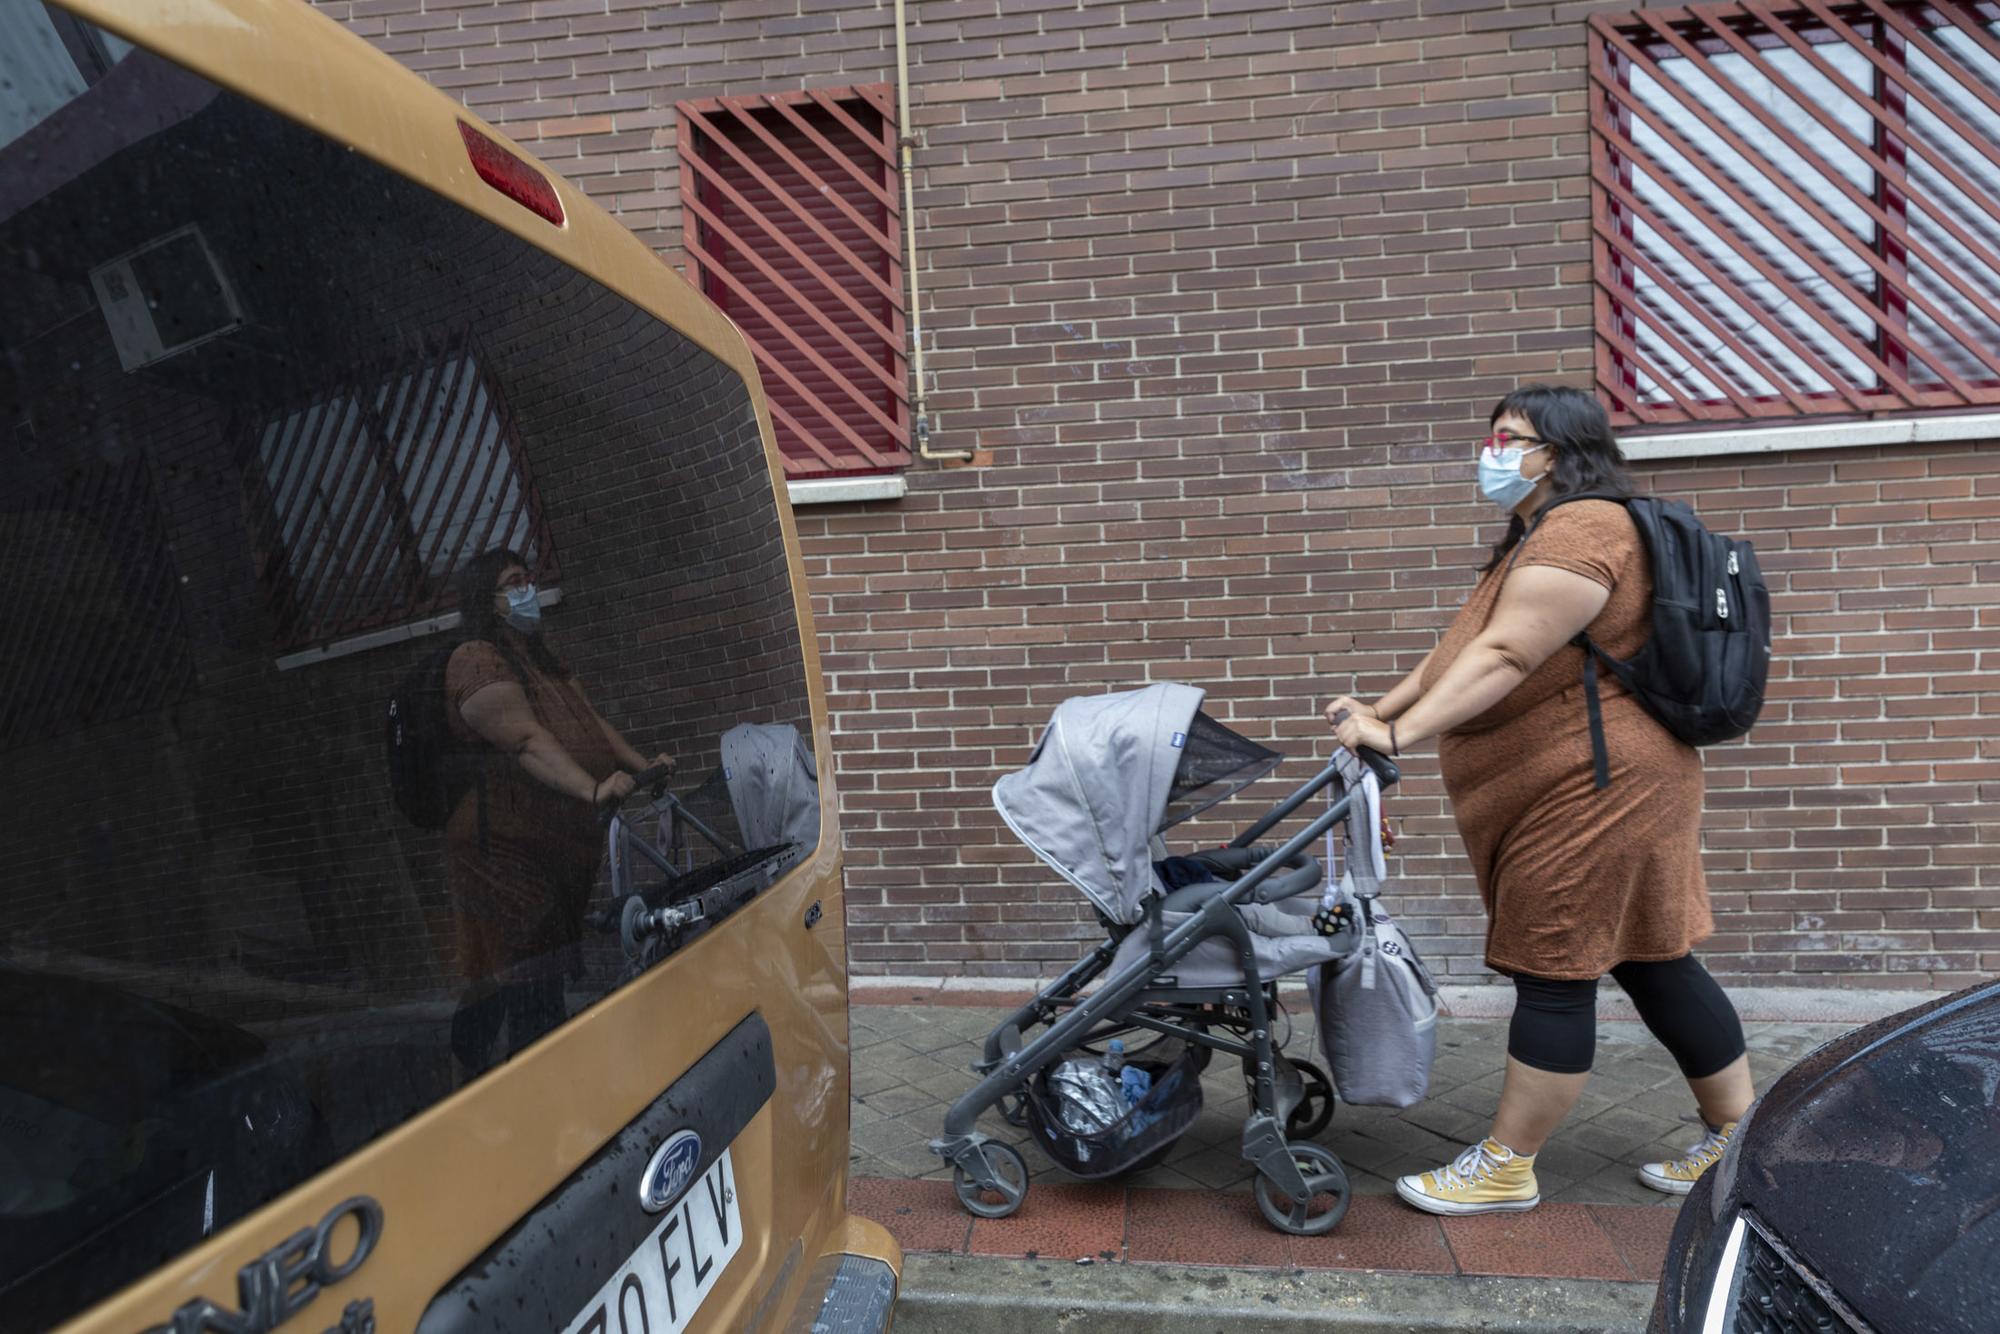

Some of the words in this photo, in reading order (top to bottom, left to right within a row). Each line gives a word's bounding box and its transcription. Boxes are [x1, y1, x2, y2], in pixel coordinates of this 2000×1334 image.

[662, 1144, 693, 1198] Ford
[139, 1195, 385, 1334] NEO
[659, 1158, 728, 1324] FLV
